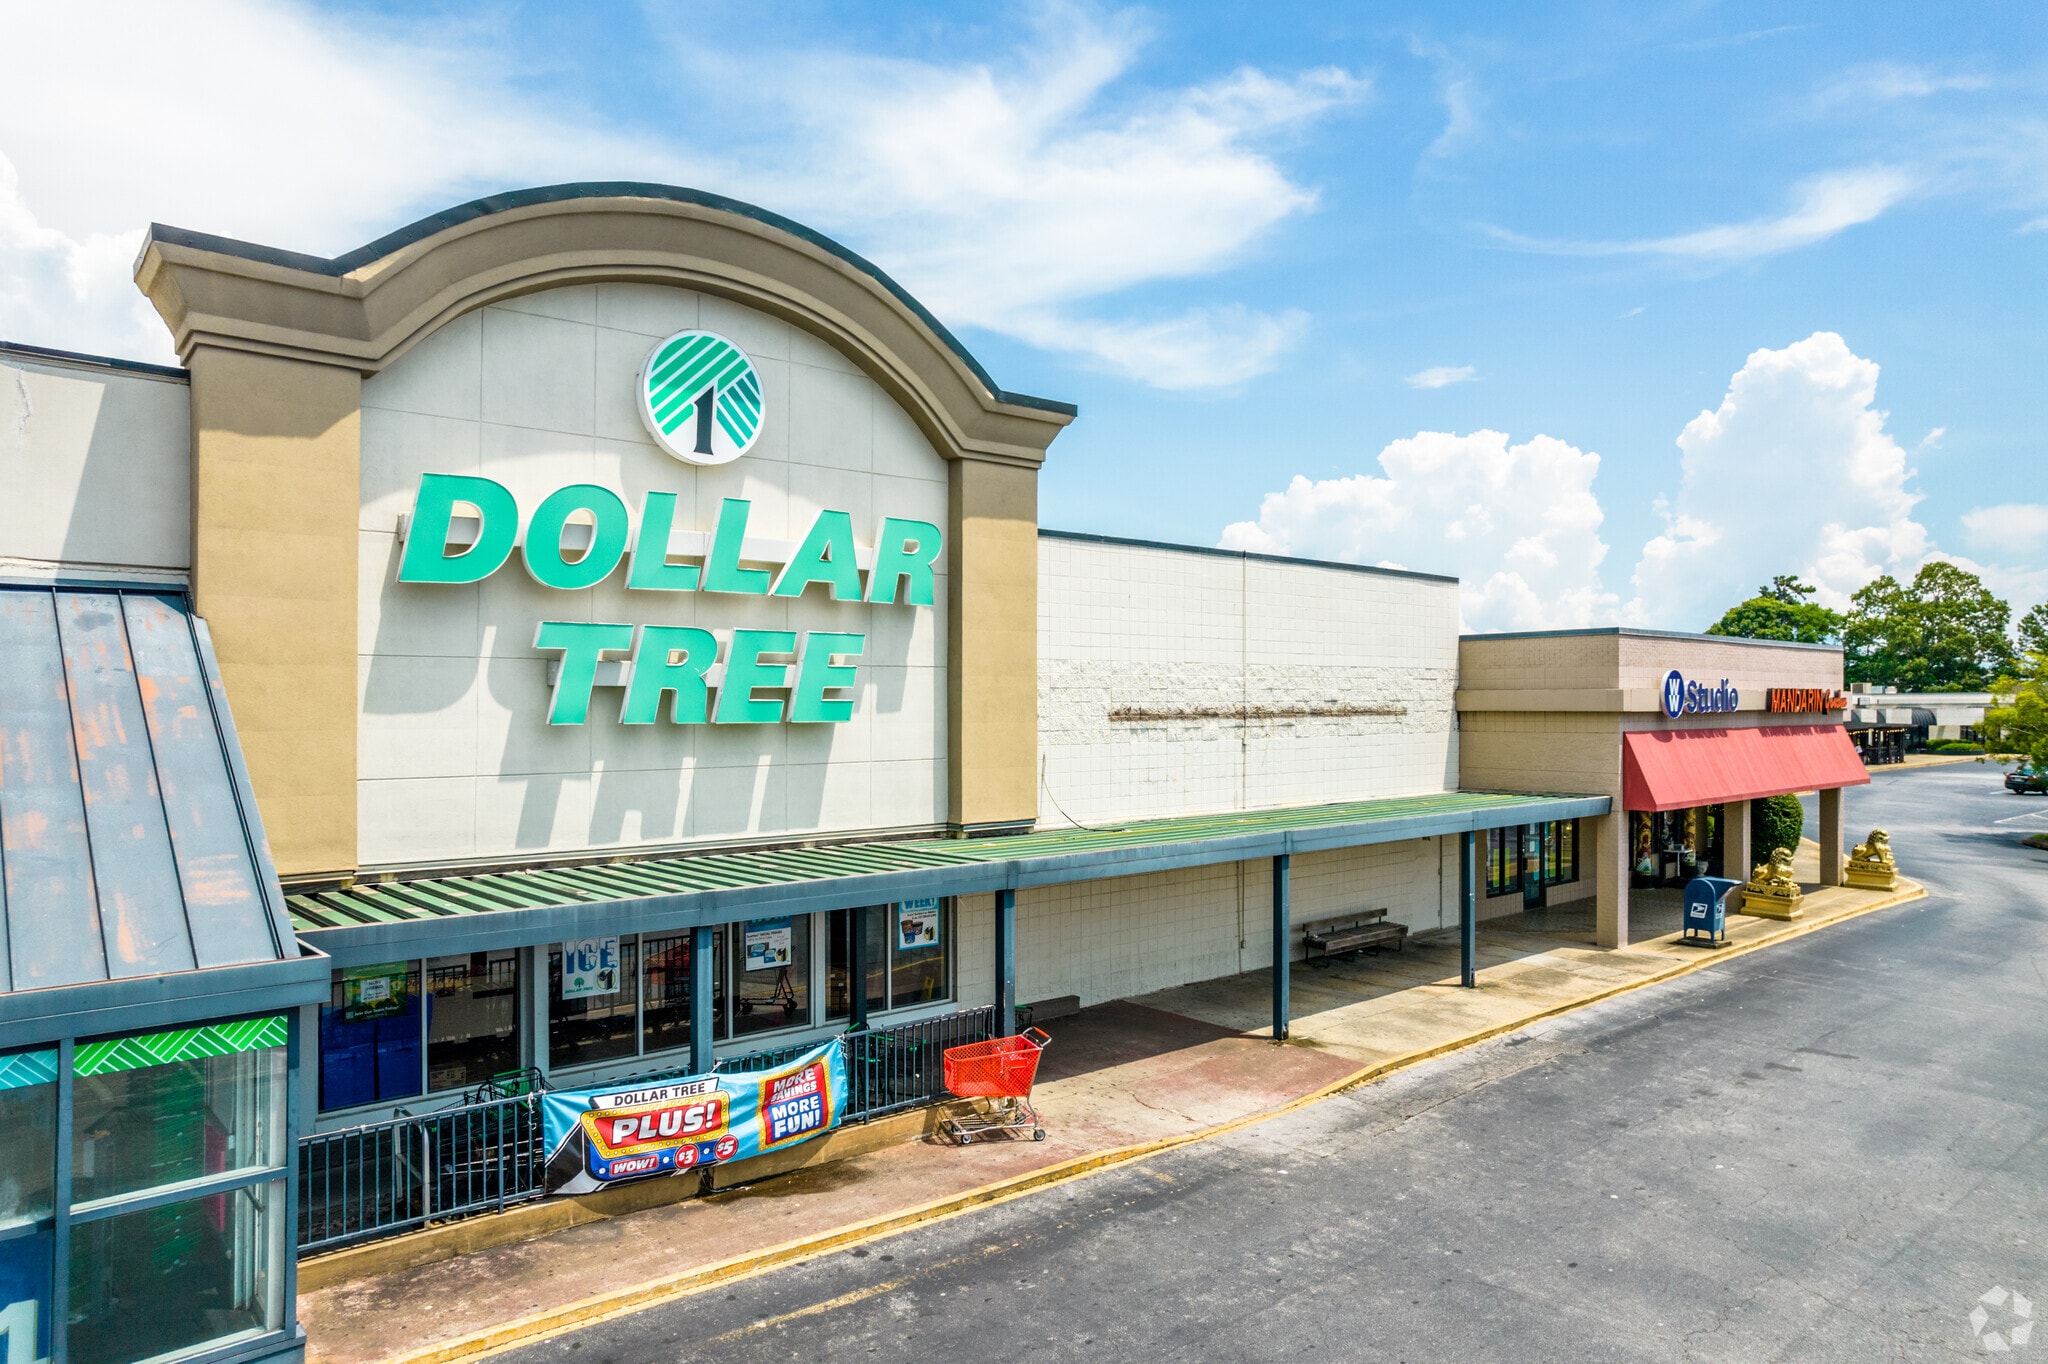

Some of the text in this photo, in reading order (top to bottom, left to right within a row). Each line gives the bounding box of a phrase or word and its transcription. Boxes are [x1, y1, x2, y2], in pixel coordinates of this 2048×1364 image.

[396, 472, 942, 607] DOLLAR
[532, 620, 866, 726] TREE
[1686, 678, 1739, 713] Studio
[1769, 687, 1824, 713] MANDARIN
[565, 935, 618, 975] ICE
[614, 1083, 706, 1107] DOLLAR TREE
[771, 1080, 818, 1102] SAVINGS
[773, 1066, 816, 1094] MORE
[611, 1103, 716, 1145] PLUS!
[771, 1095, 820, 1121] MORE
[774, 1109, 821, 1139] FUN!
[613, 1140, 734, 1174] WOW! $3 $5
